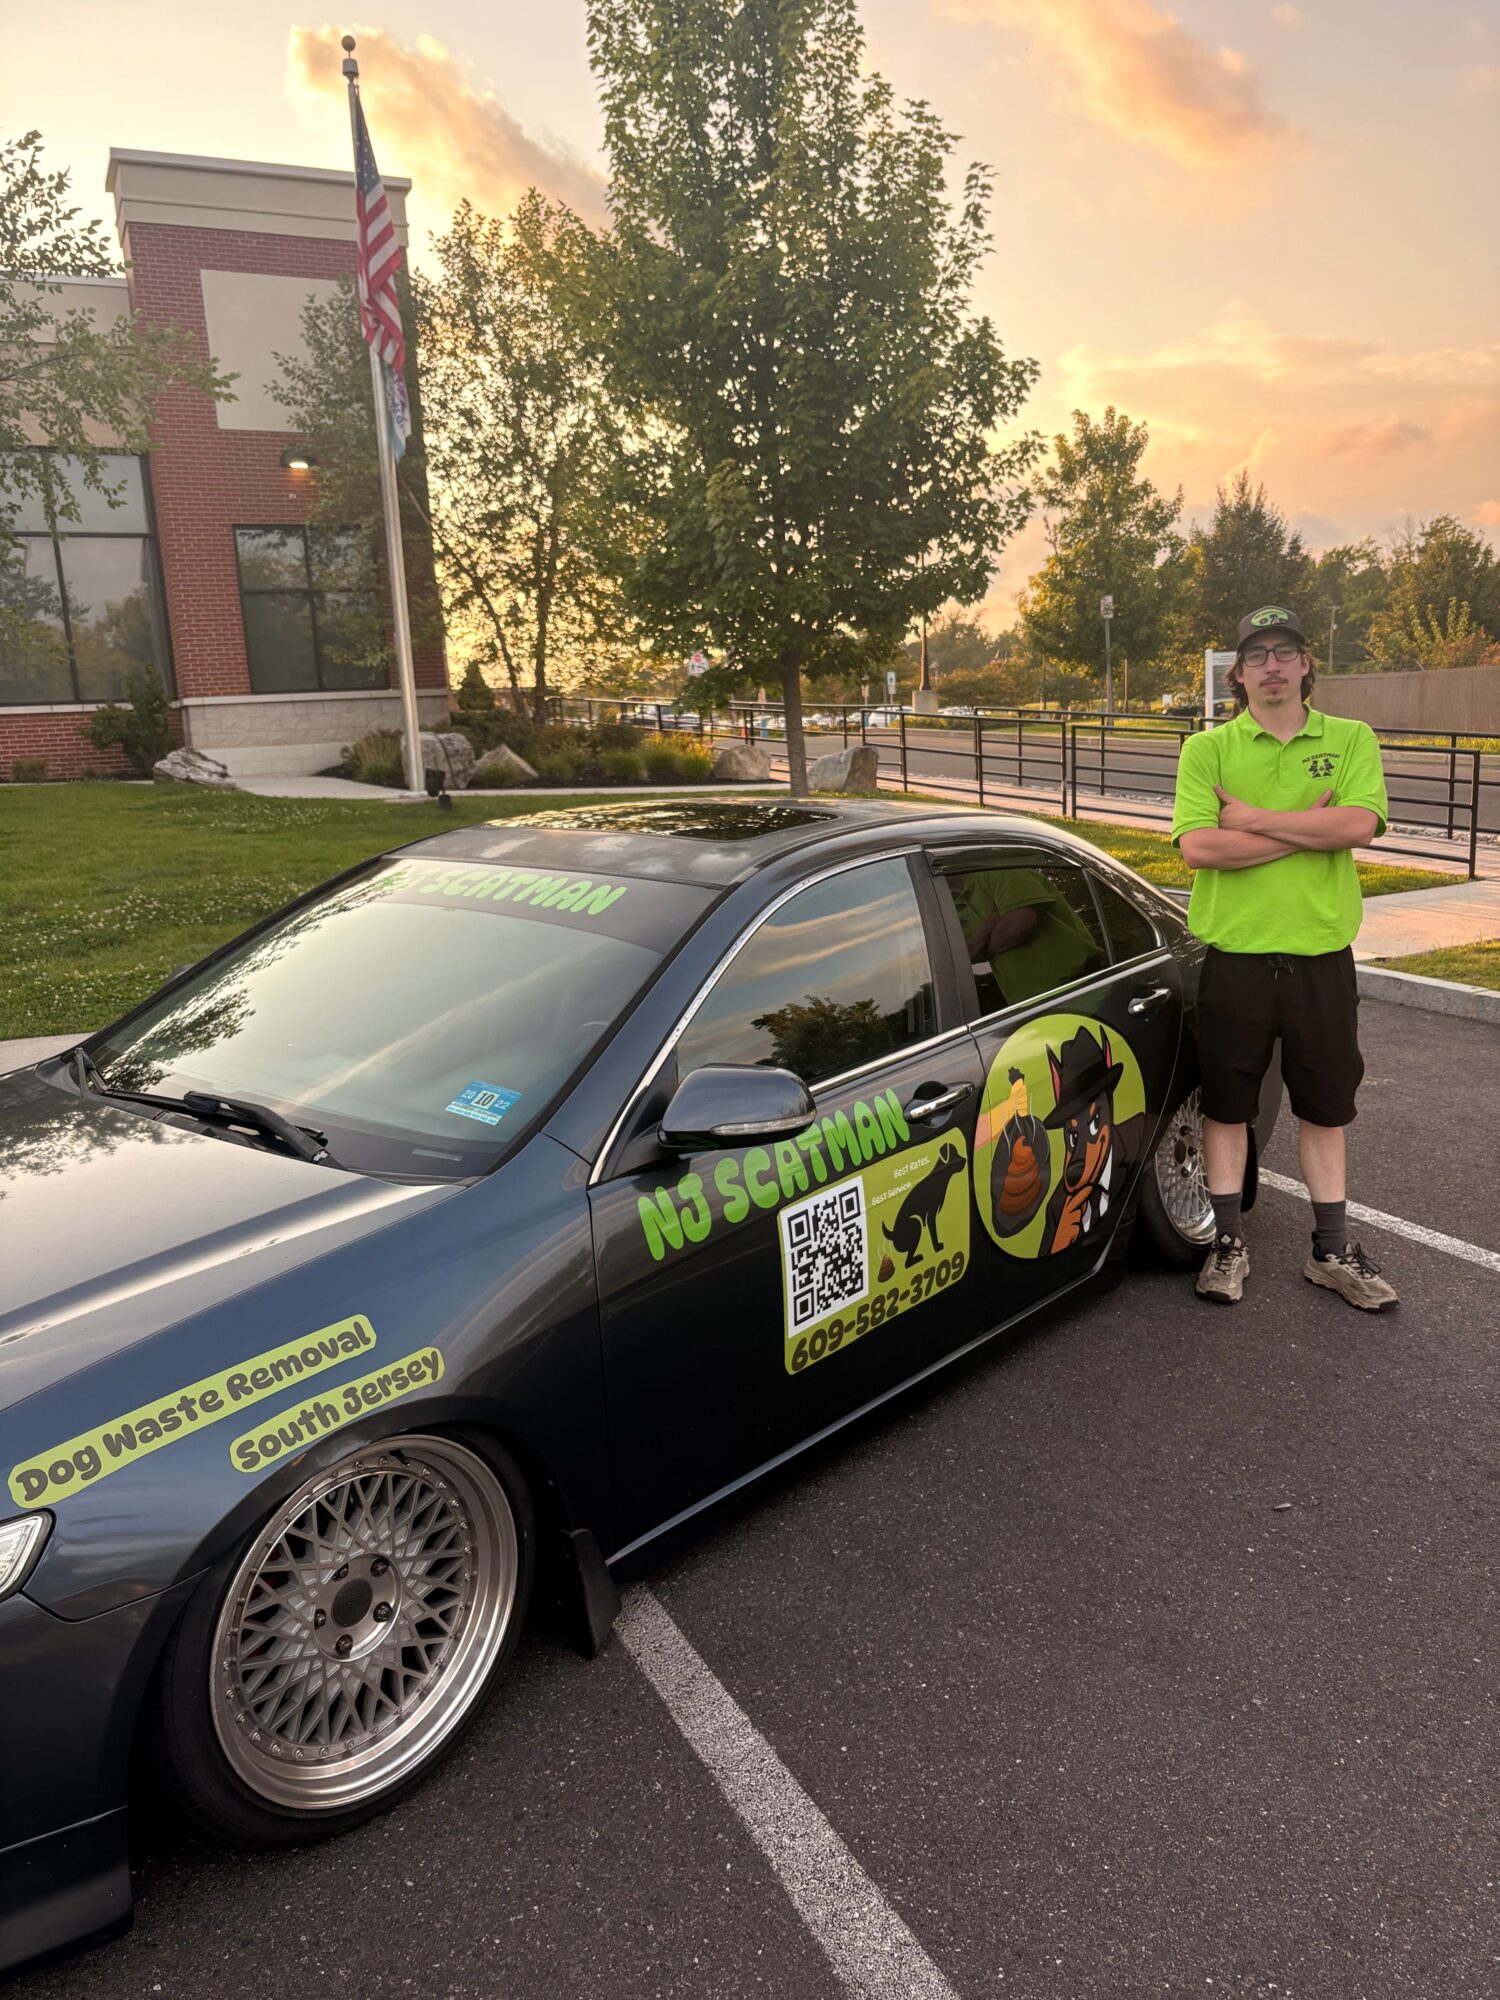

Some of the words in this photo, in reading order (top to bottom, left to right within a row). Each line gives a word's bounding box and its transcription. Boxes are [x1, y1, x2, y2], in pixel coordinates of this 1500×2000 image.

[417, 868, 628, 916] SCATMAN
[475, 1092, 494, 1106] 10
[637, 1173, 713, 1262] NJ
[713, 1088, 911, 1224] SCATMAN
[871, 1192, 887, 1206] Best
[893, 1164, 909, 1179] Best
[791, 1250, 966, 1372] 609-582-3709
[15, 1444, 103, 1502] Dog
[102, 1388, 225, 1459] Waste
[226, 1320, 372, 1402] Removal
[235, 1400, 341, 1470] South
[343, 1349, 441, 1416] Jersey
